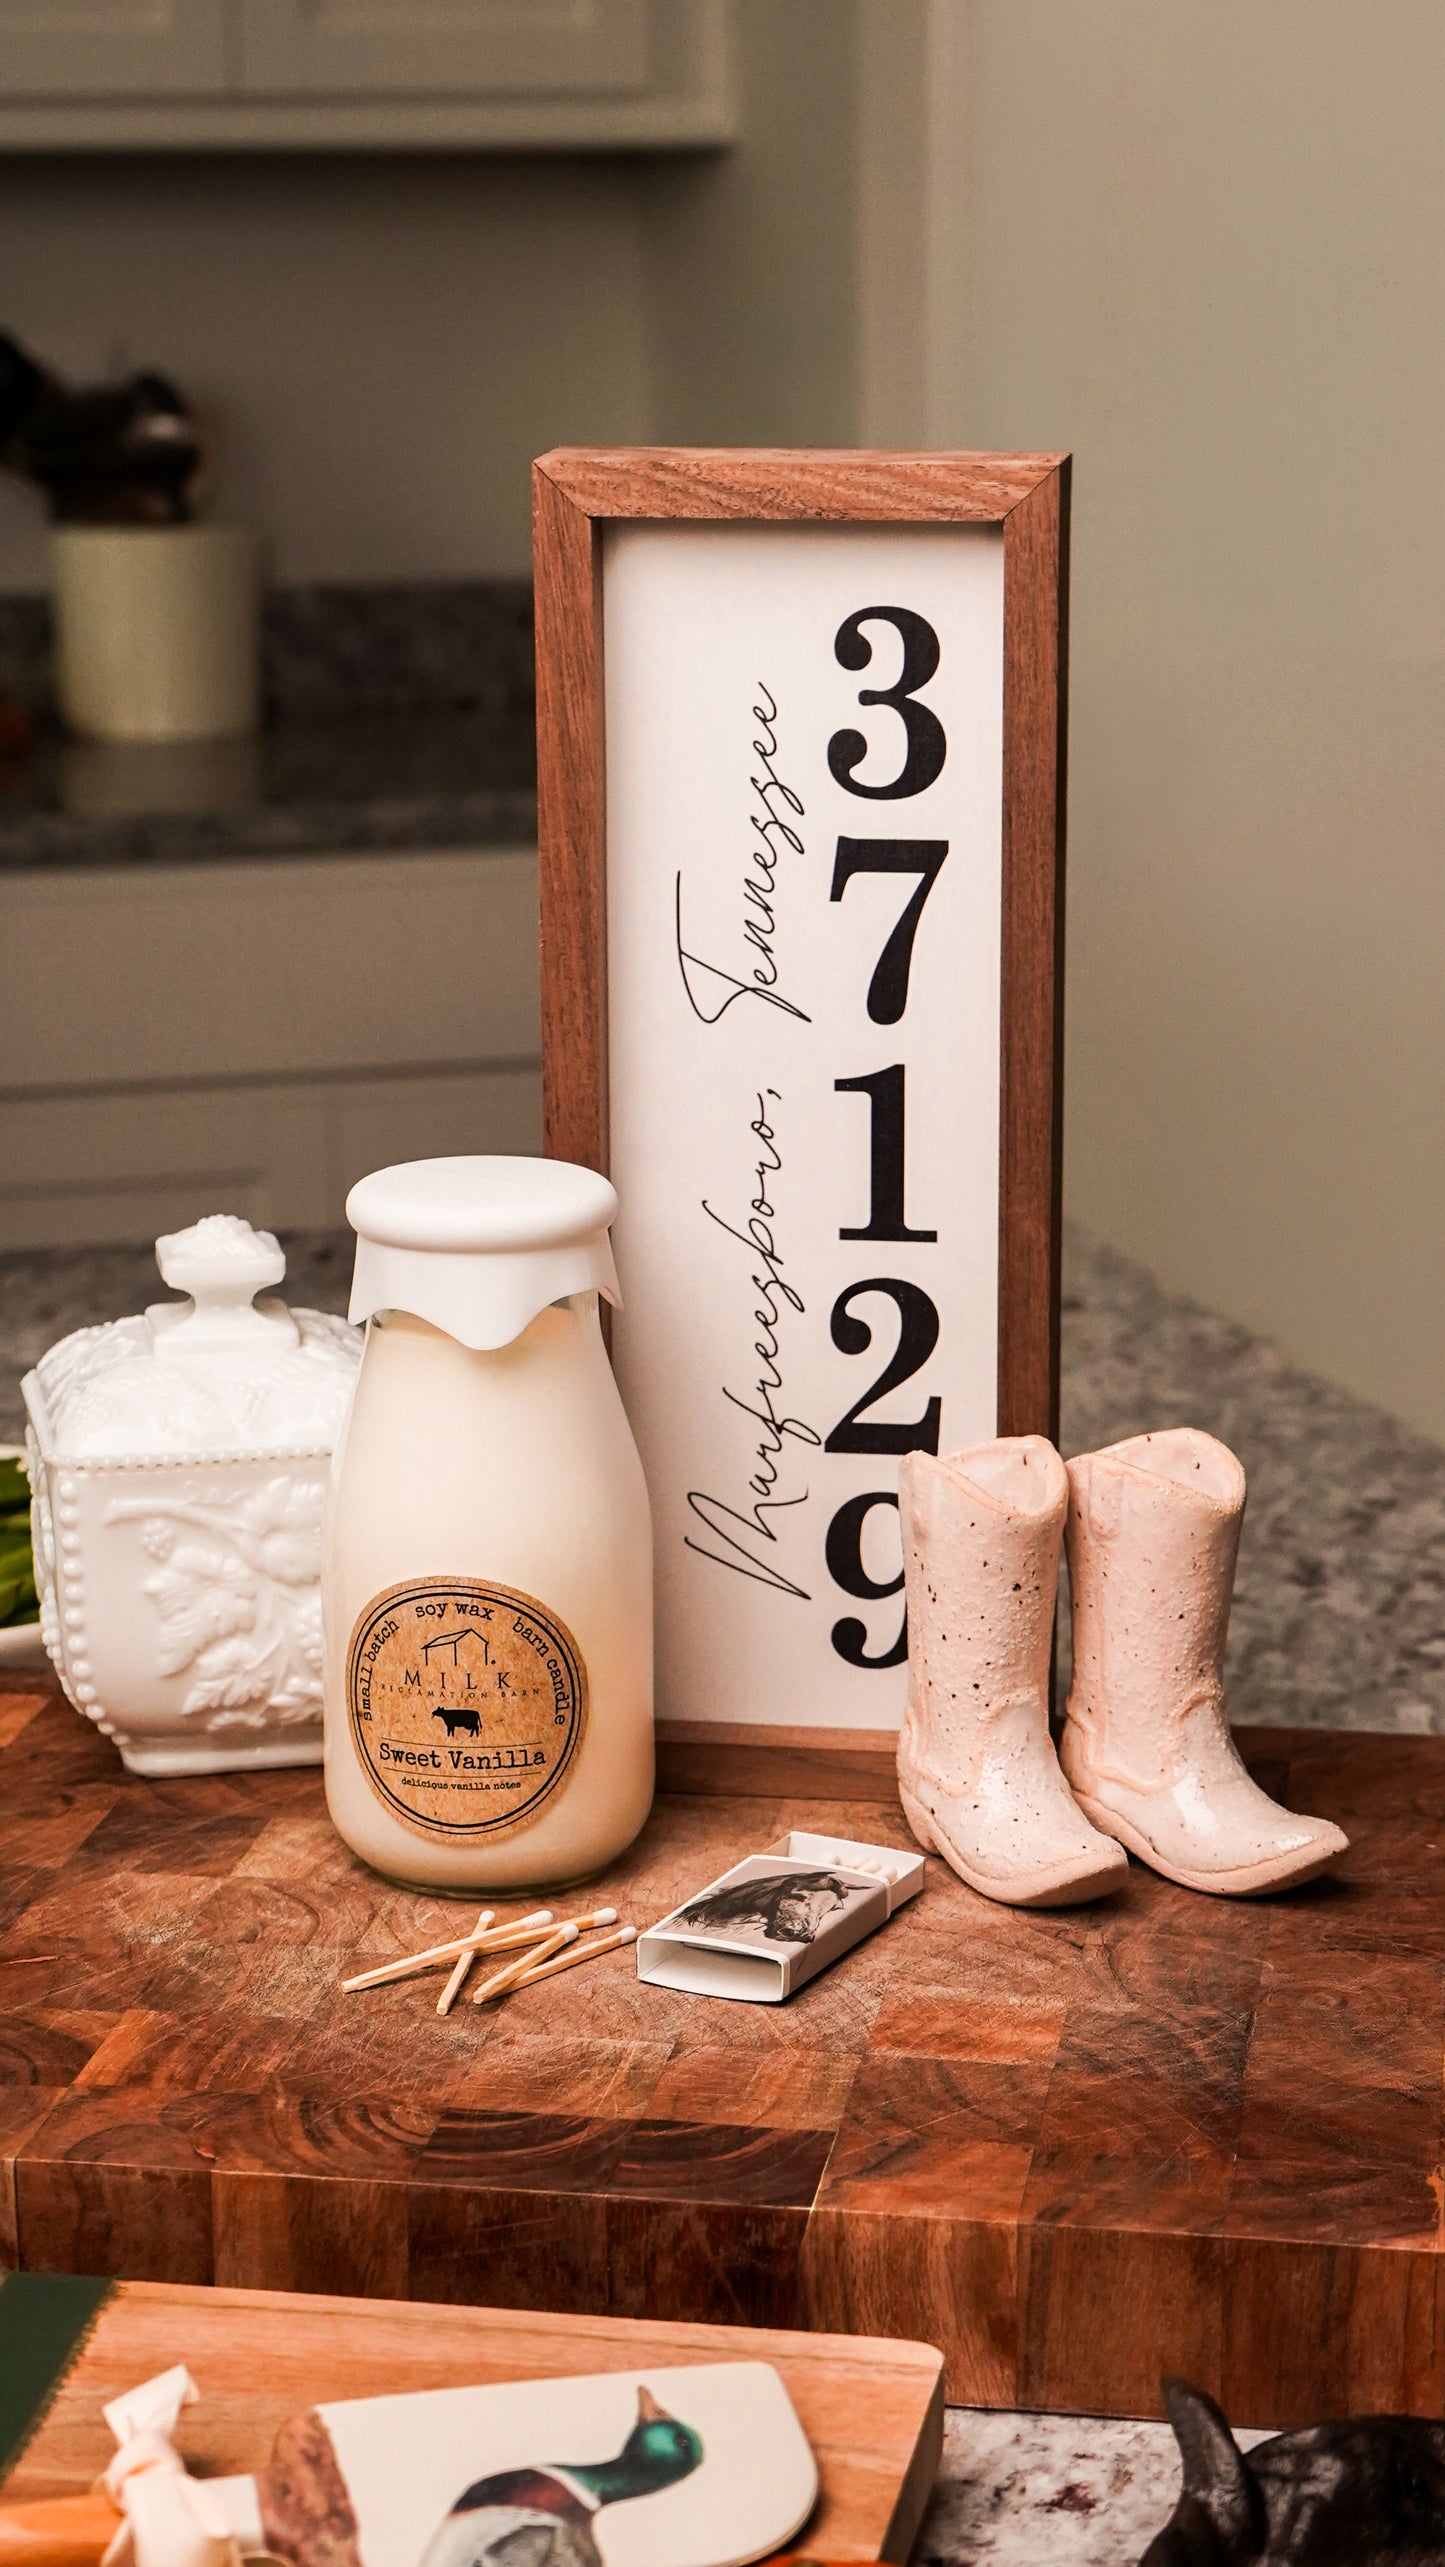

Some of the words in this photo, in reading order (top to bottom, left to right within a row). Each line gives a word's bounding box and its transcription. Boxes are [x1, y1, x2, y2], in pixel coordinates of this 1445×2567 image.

[675, 681, 813, 1025] Tennessee
[415, 1602, 449, 1620] soy
[454, 1602, 496, 1622] wax
[364, 1619, 400, 1664] batch
[511, 1616, 550, 1658] barn
[546, 1657, 571, 1726] candle
[362, 1666, 374, 1722] small
[500, 1687, 541, 1698] BARN
[379, 1742, 442, 1769] Sweet
[447, 1750, 547, 1771] Vanilla
[400, 1776, 449, 1790] delicious
[450, 1780, 491, 1791] vanilla
[492, 1780, 522, 1791] notes
